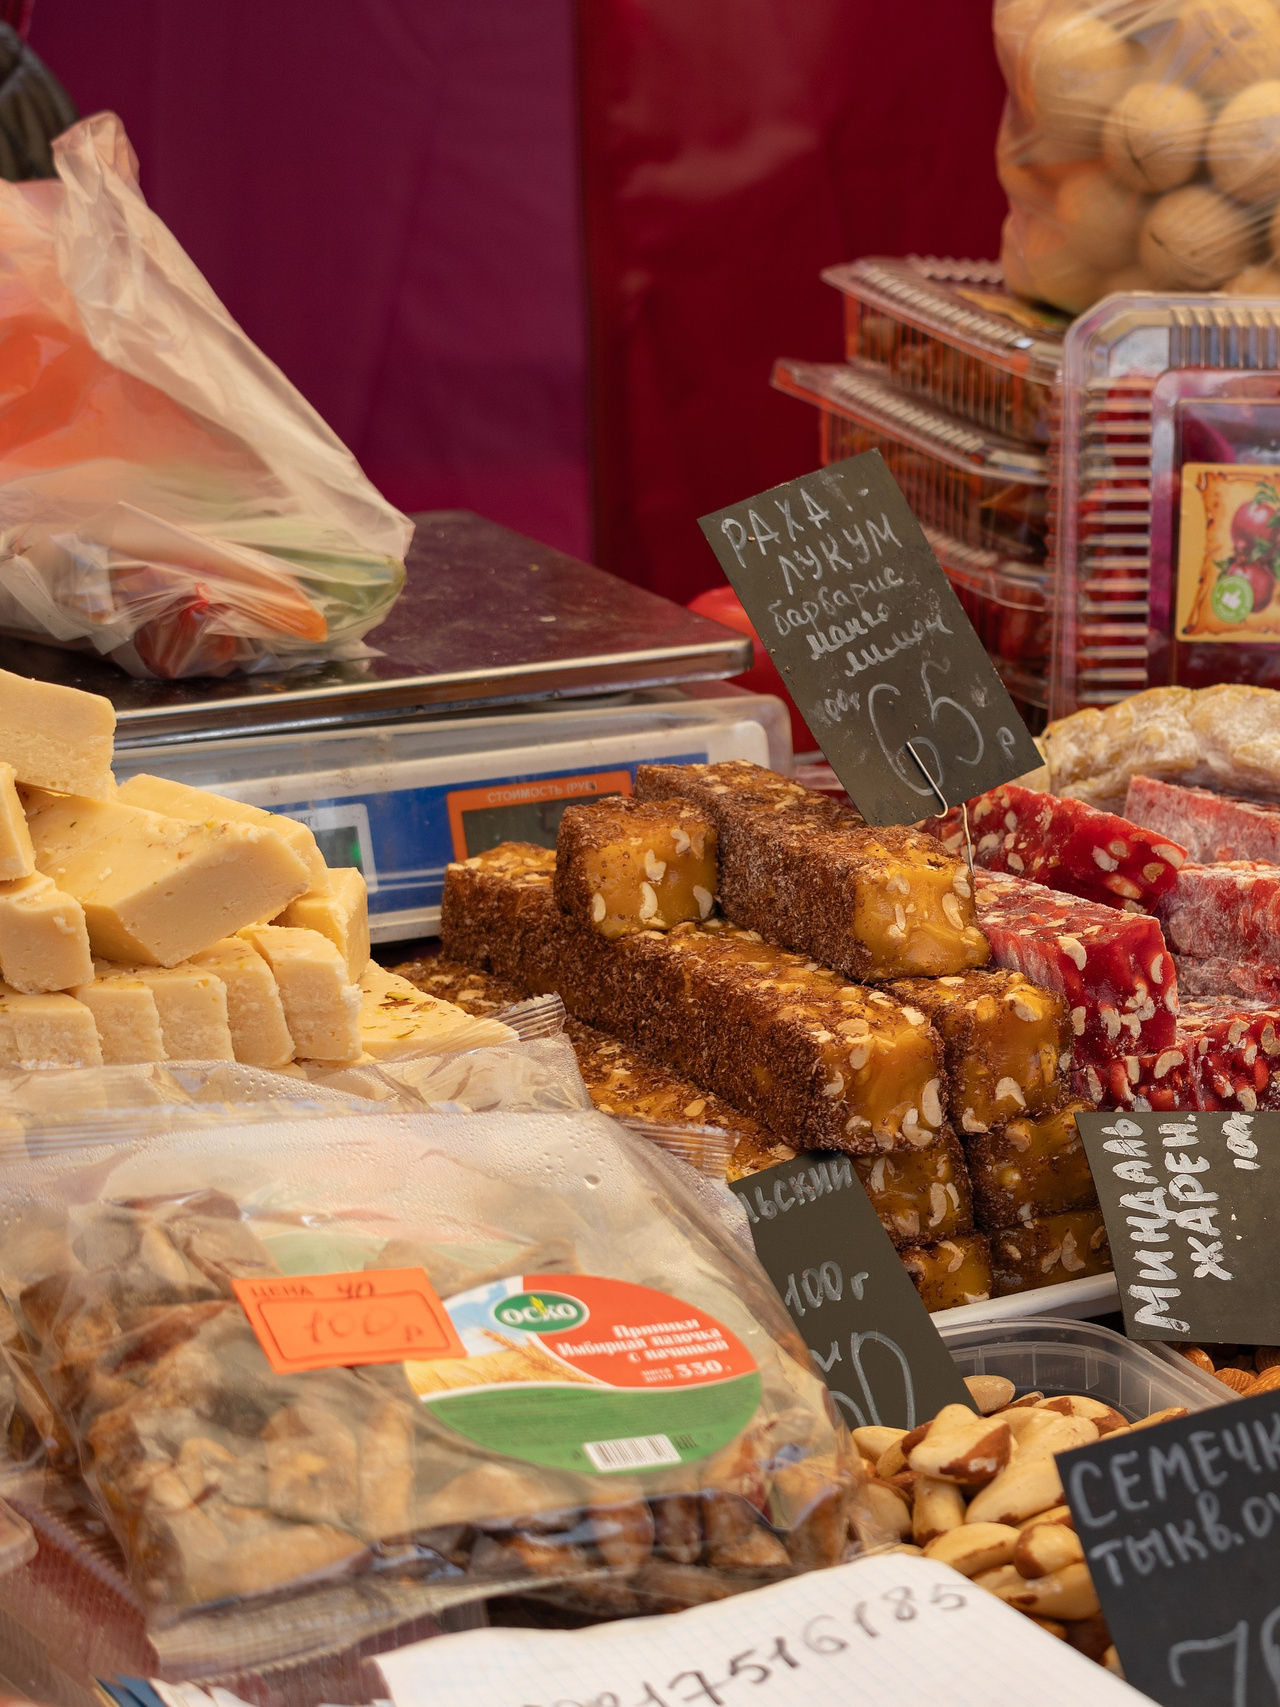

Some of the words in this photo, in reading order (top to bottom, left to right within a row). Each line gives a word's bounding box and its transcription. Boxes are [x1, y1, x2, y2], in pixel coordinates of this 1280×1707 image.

[777, 512, 903, 595] ЛУКУМ
[487, 785, 563, 803] СТОИМОСТЬ
[1101, 1117, 1191, 1333] МИНДАЛЬ
[501, 1302, 578, 1324] ОСКО
[556, 1337, 648, 1357] Имбирная
[651, 1326, 723, 1347] палочка
[612, 1318, 700, 1340] Пряники
[644, 1336, 729, 1361] начинкой
